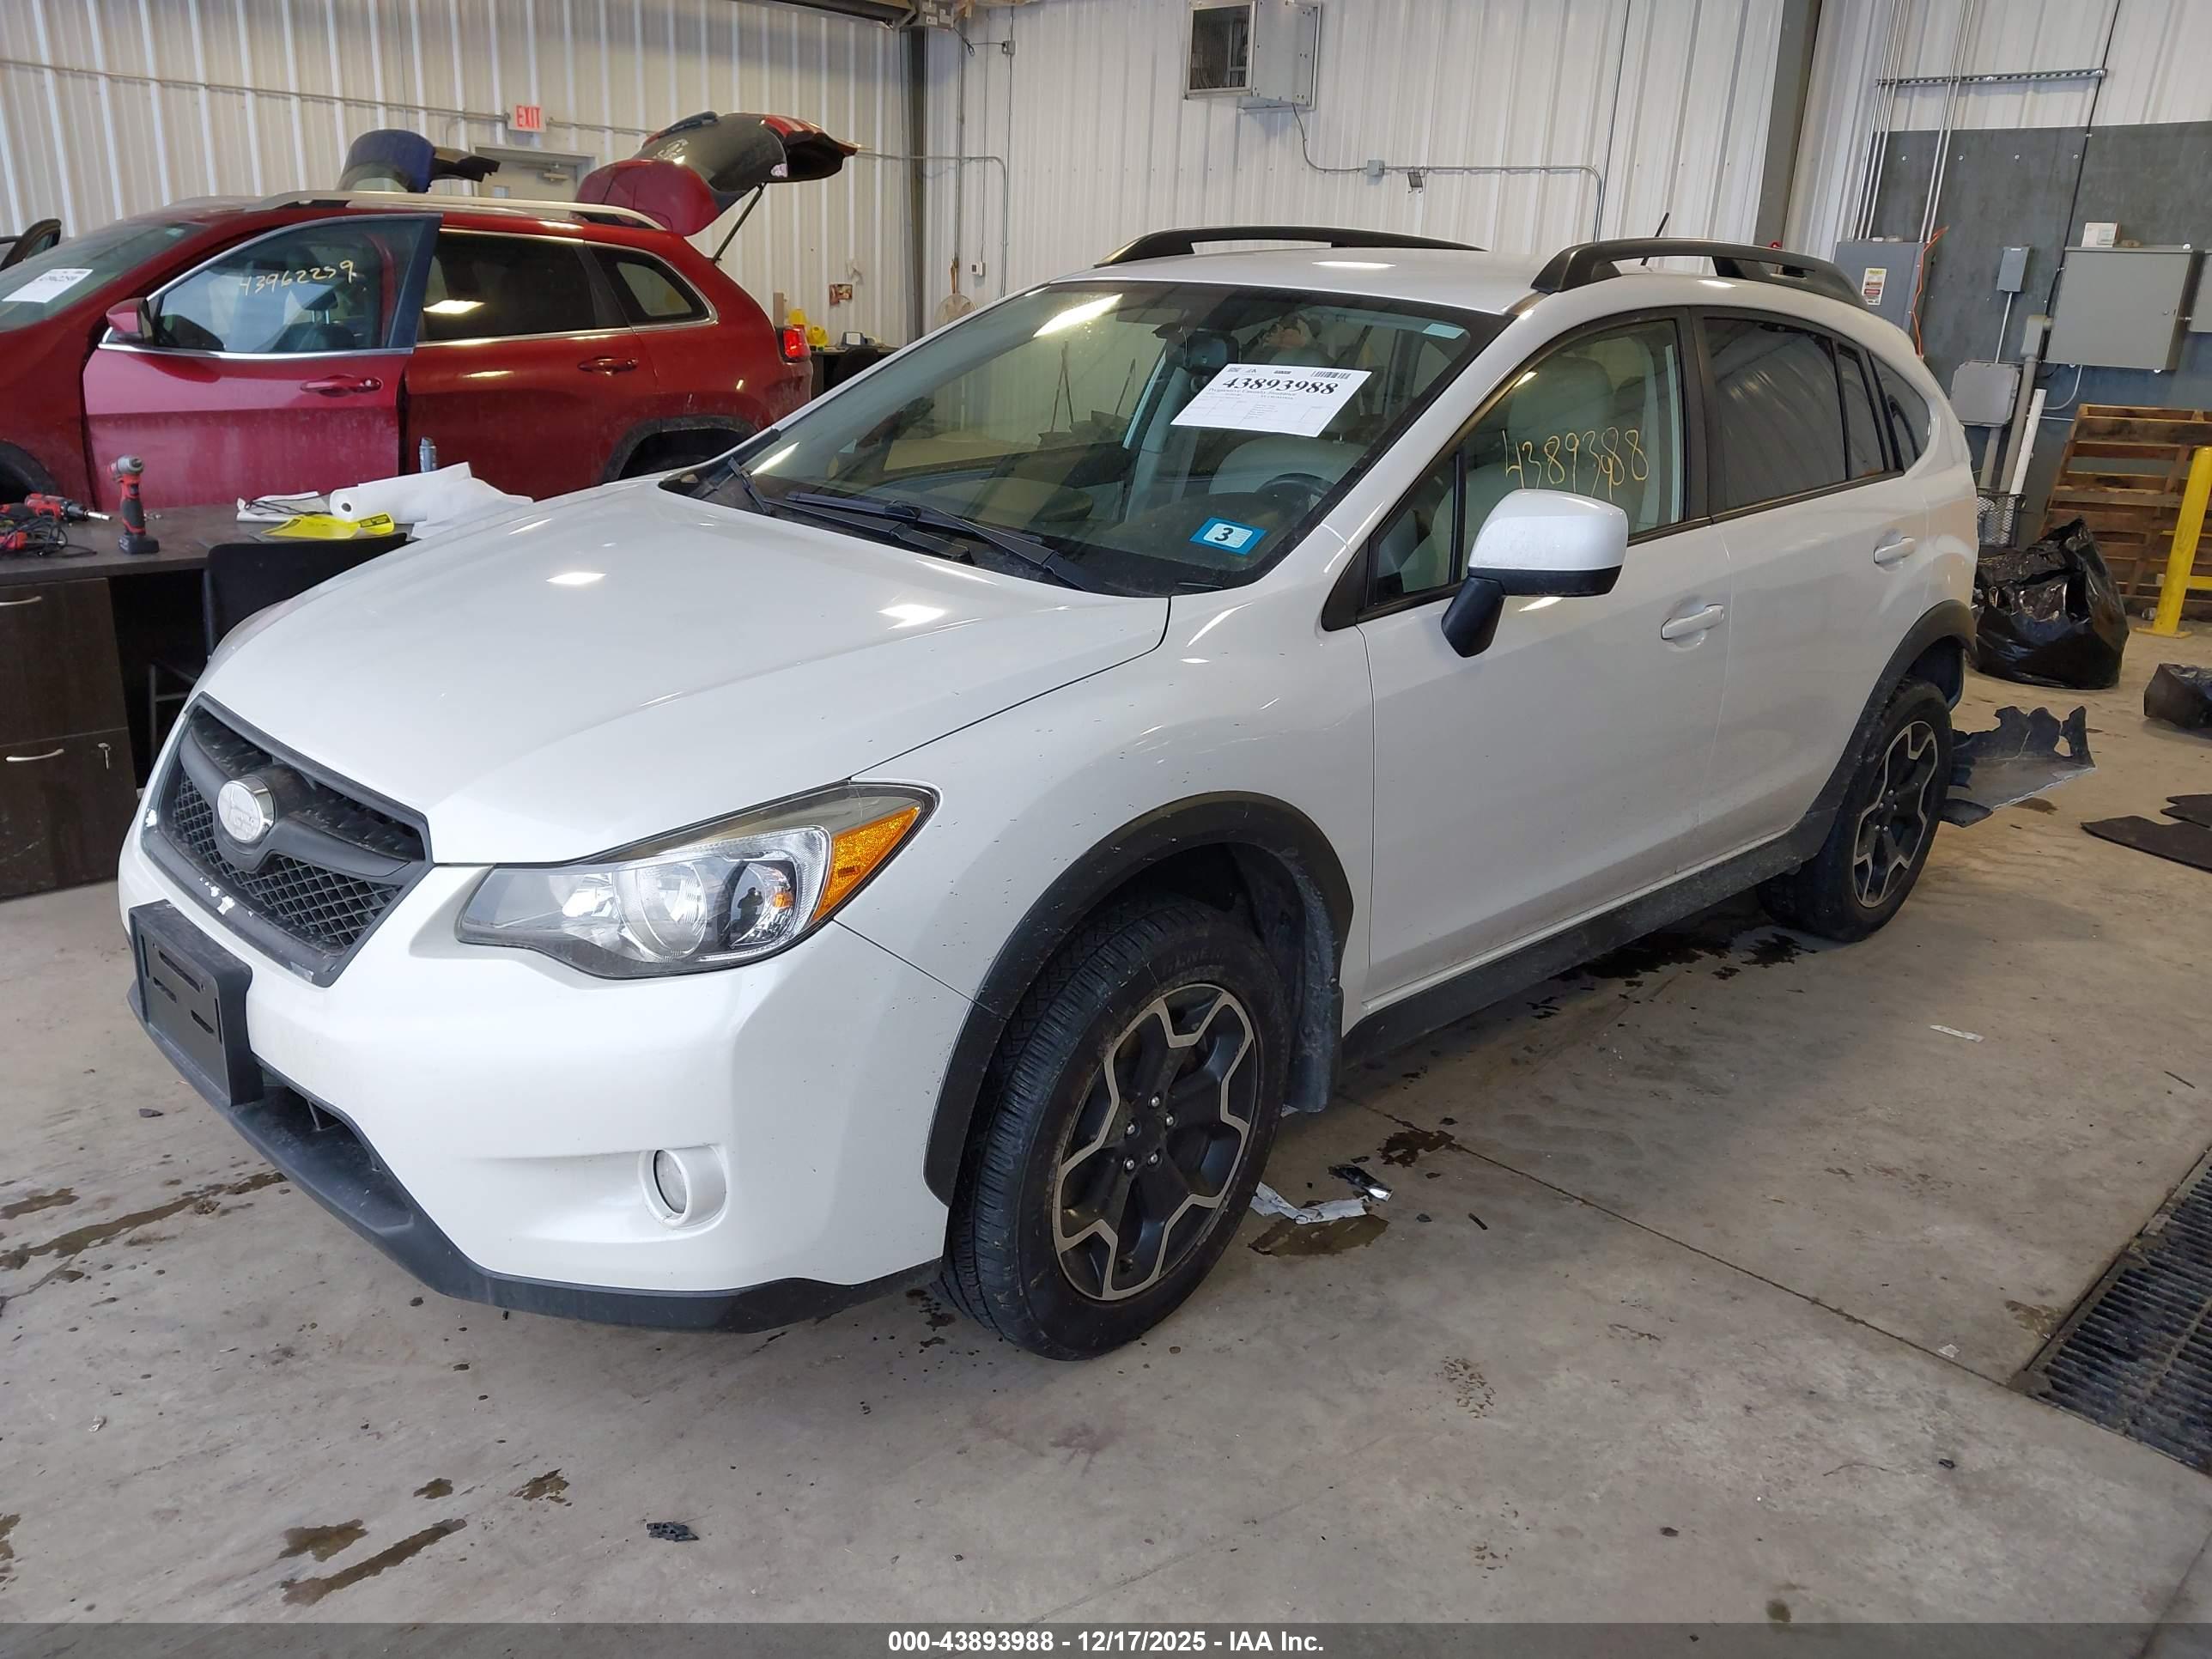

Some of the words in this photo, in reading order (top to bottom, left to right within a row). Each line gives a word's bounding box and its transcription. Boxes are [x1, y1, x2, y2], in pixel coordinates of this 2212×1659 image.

[516, 105, 541, 129] EXIT
[1223, 377, 1339, 395] 43893988
[1214, 527, 1234, 541] 3
